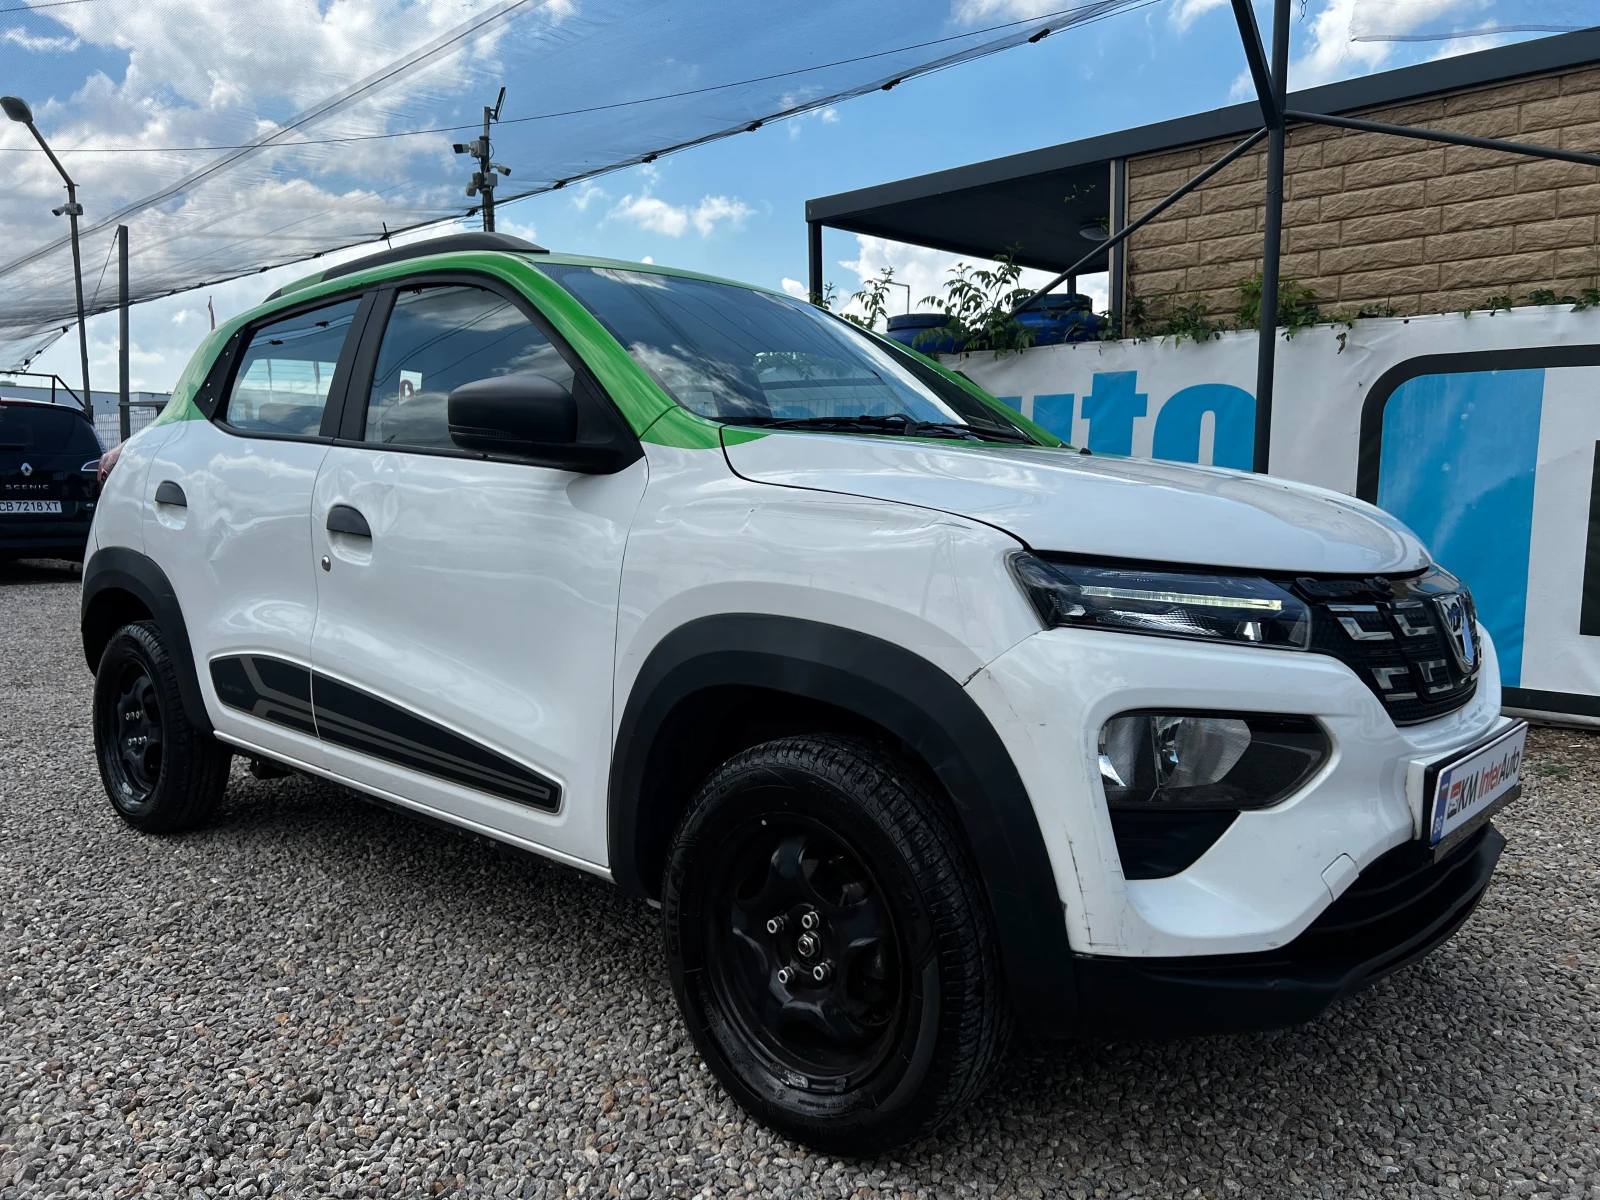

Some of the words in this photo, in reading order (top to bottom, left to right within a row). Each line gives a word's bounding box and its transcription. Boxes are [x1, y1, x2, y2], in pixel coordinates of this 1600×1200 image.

[0, 502, 13, 511] CB
[15, 502, 43, 511] 7218
[44, 502, 58, 511] XT
[1457, 771, 1478, 812] KM
